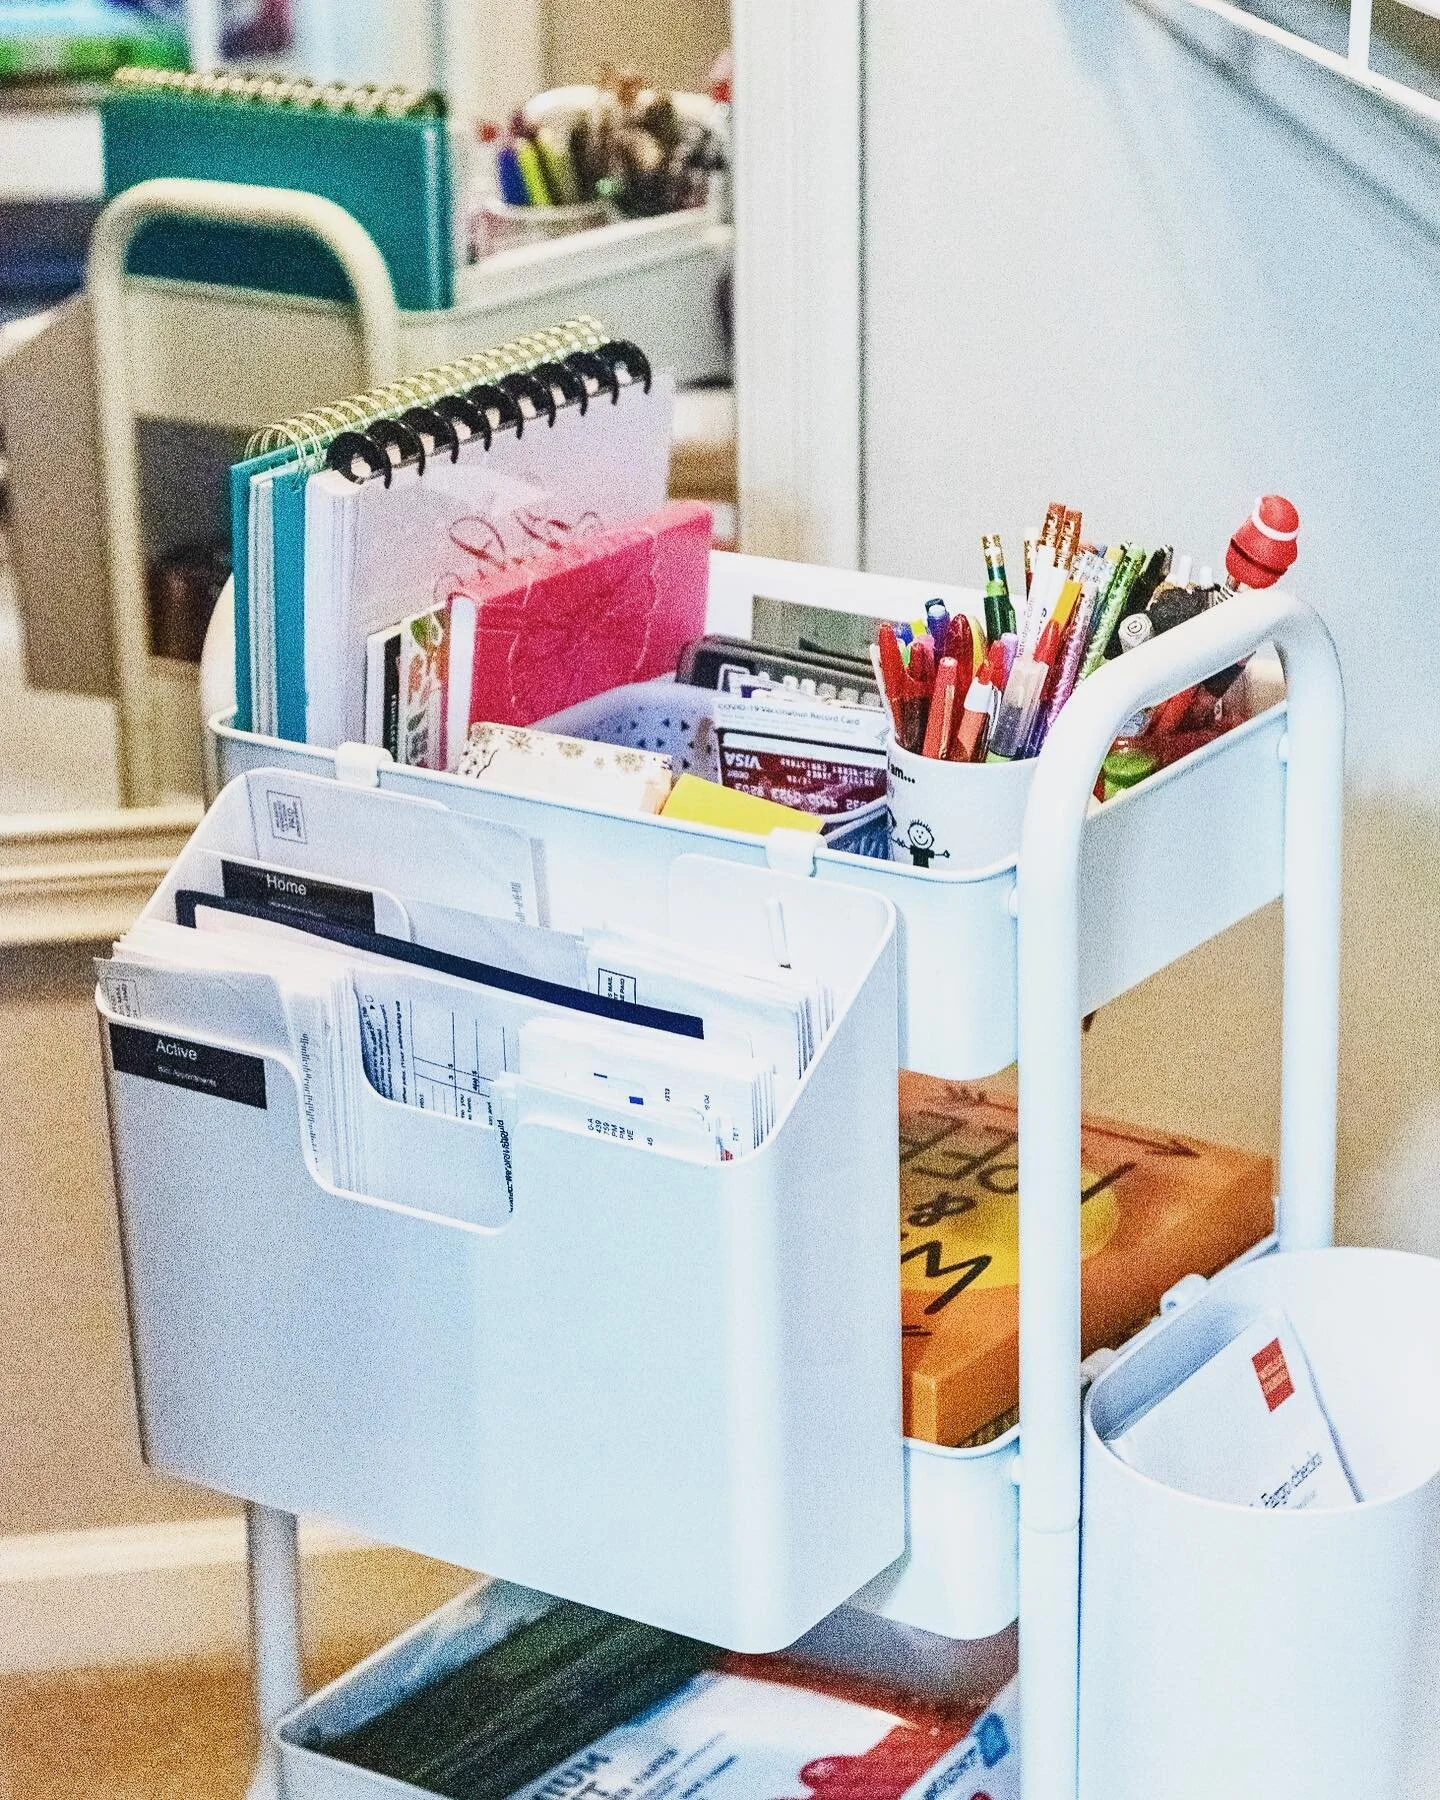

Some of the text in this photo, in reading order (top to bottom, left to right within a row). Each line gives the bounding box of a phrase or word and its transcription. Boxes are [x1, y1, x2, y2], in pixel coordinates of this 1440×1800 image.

[759, 705, 808, 718] Vaccination
[810, 711, 839, 722] Record
[840, 714, 861, 726] Card
[724, 751, 763, 770] VISA
[266, 873, 307, 896] Home
[155, 1039, 198, 1061] Active
